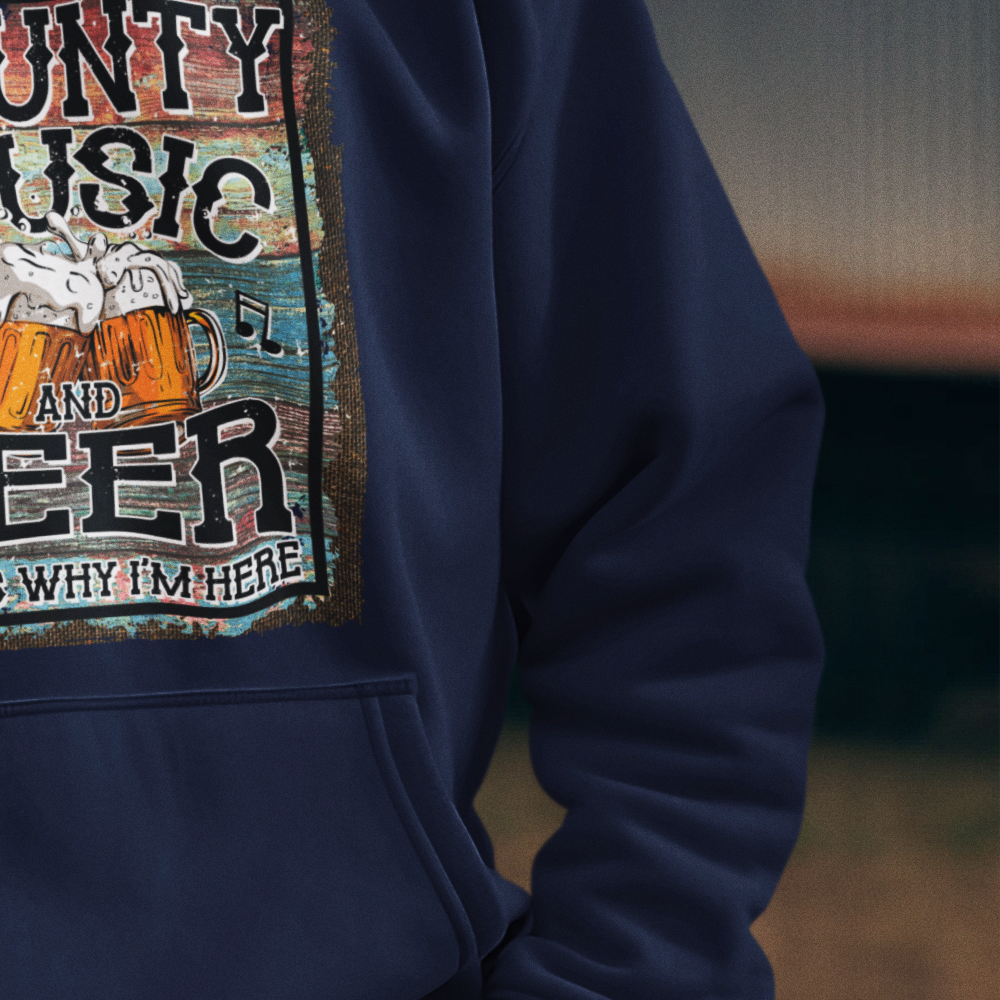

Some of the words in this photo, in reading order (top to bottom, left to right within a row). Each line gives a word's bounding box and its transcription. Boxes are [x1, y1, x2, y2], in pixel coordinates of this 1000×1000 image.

[35, 381, 121, 423] AND
[18, 561, 116, 602] WHY
[129, 558, 192, 600] I'M
[205, 540, 301, 602] HERE
